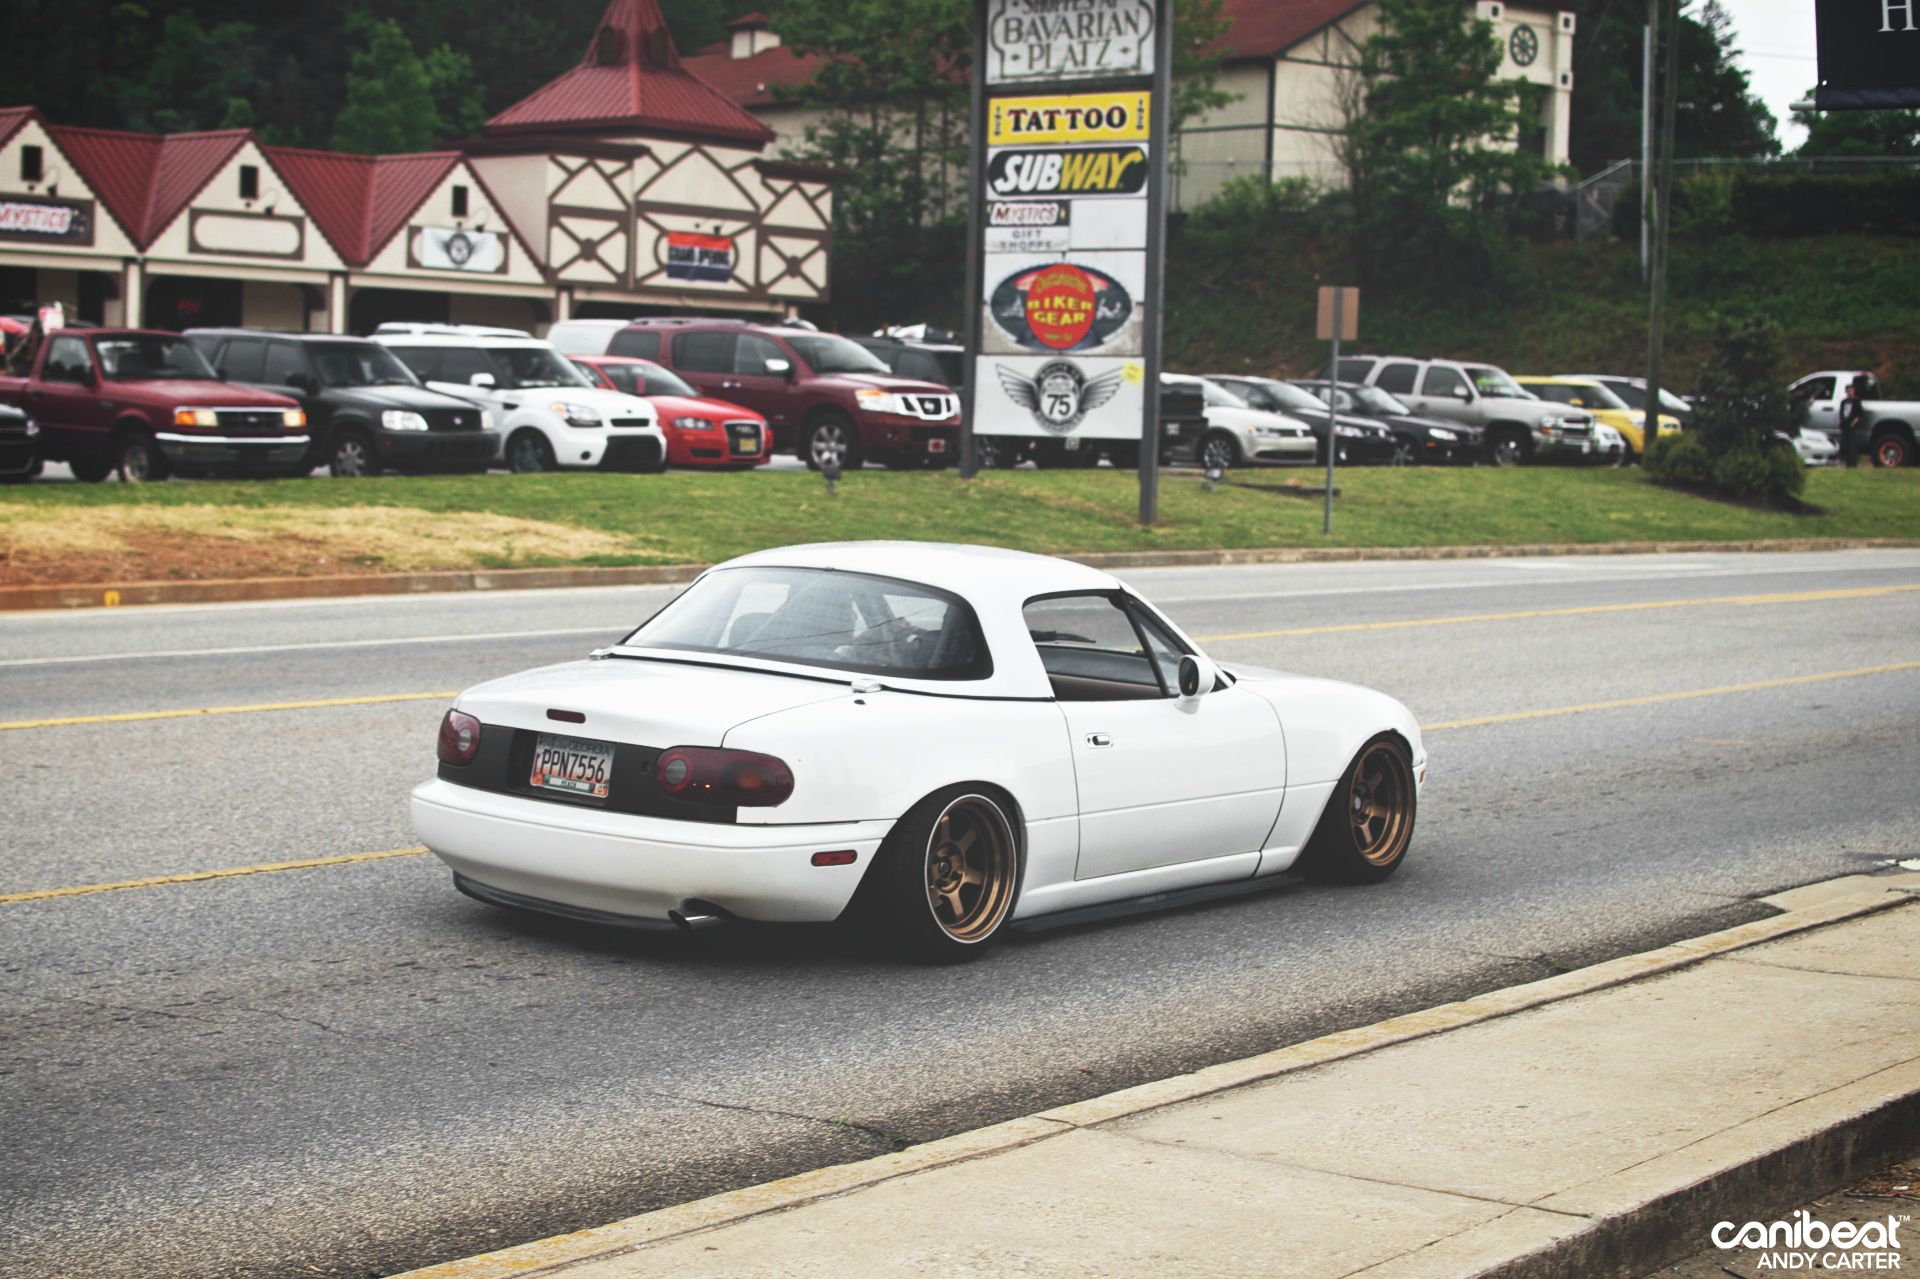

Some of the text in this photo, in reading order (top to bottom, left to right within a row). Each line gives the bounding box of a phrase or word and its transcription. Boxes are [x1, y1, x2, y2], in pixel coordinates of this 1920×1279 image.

[1003, 9, 1140, 44] BAVARIAN
[1027, 39, 1111, 70] PLATZ
[1008, 106, 1127, 132] TATTOO
[994, 150, 1143, 193] SUBWAY
[994, 205, 1056, 223] MYSTICS
[1012, 230, 1042, 239] GIFT
[1027, 295, 1092, 312] BIKER
[1033, 311, 1085, 326] GEAR
[1047, 394, 1071, 416] 75
[540, 748, 606, 784] PPN7556
